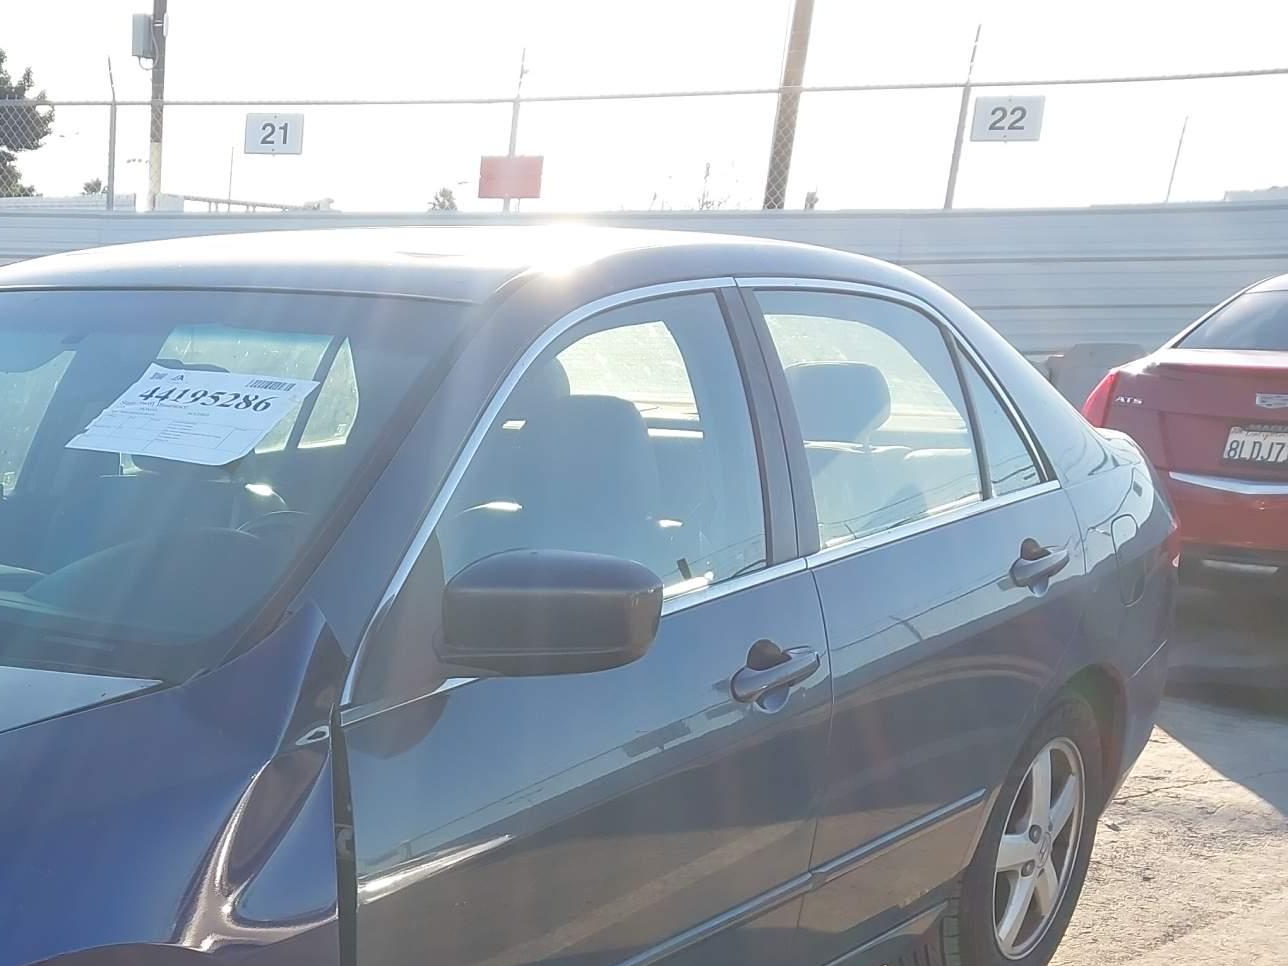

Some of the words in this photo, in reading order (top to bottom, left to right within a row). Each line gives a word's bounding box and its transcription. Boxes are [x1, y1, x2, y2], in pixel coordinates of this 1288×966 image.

[988, 106, 1027, 131] 22
[260, 122, 288, 145] 21
[138, 386, 280, 412] 44195286
[1114, 396, 1142, 405] ATS
